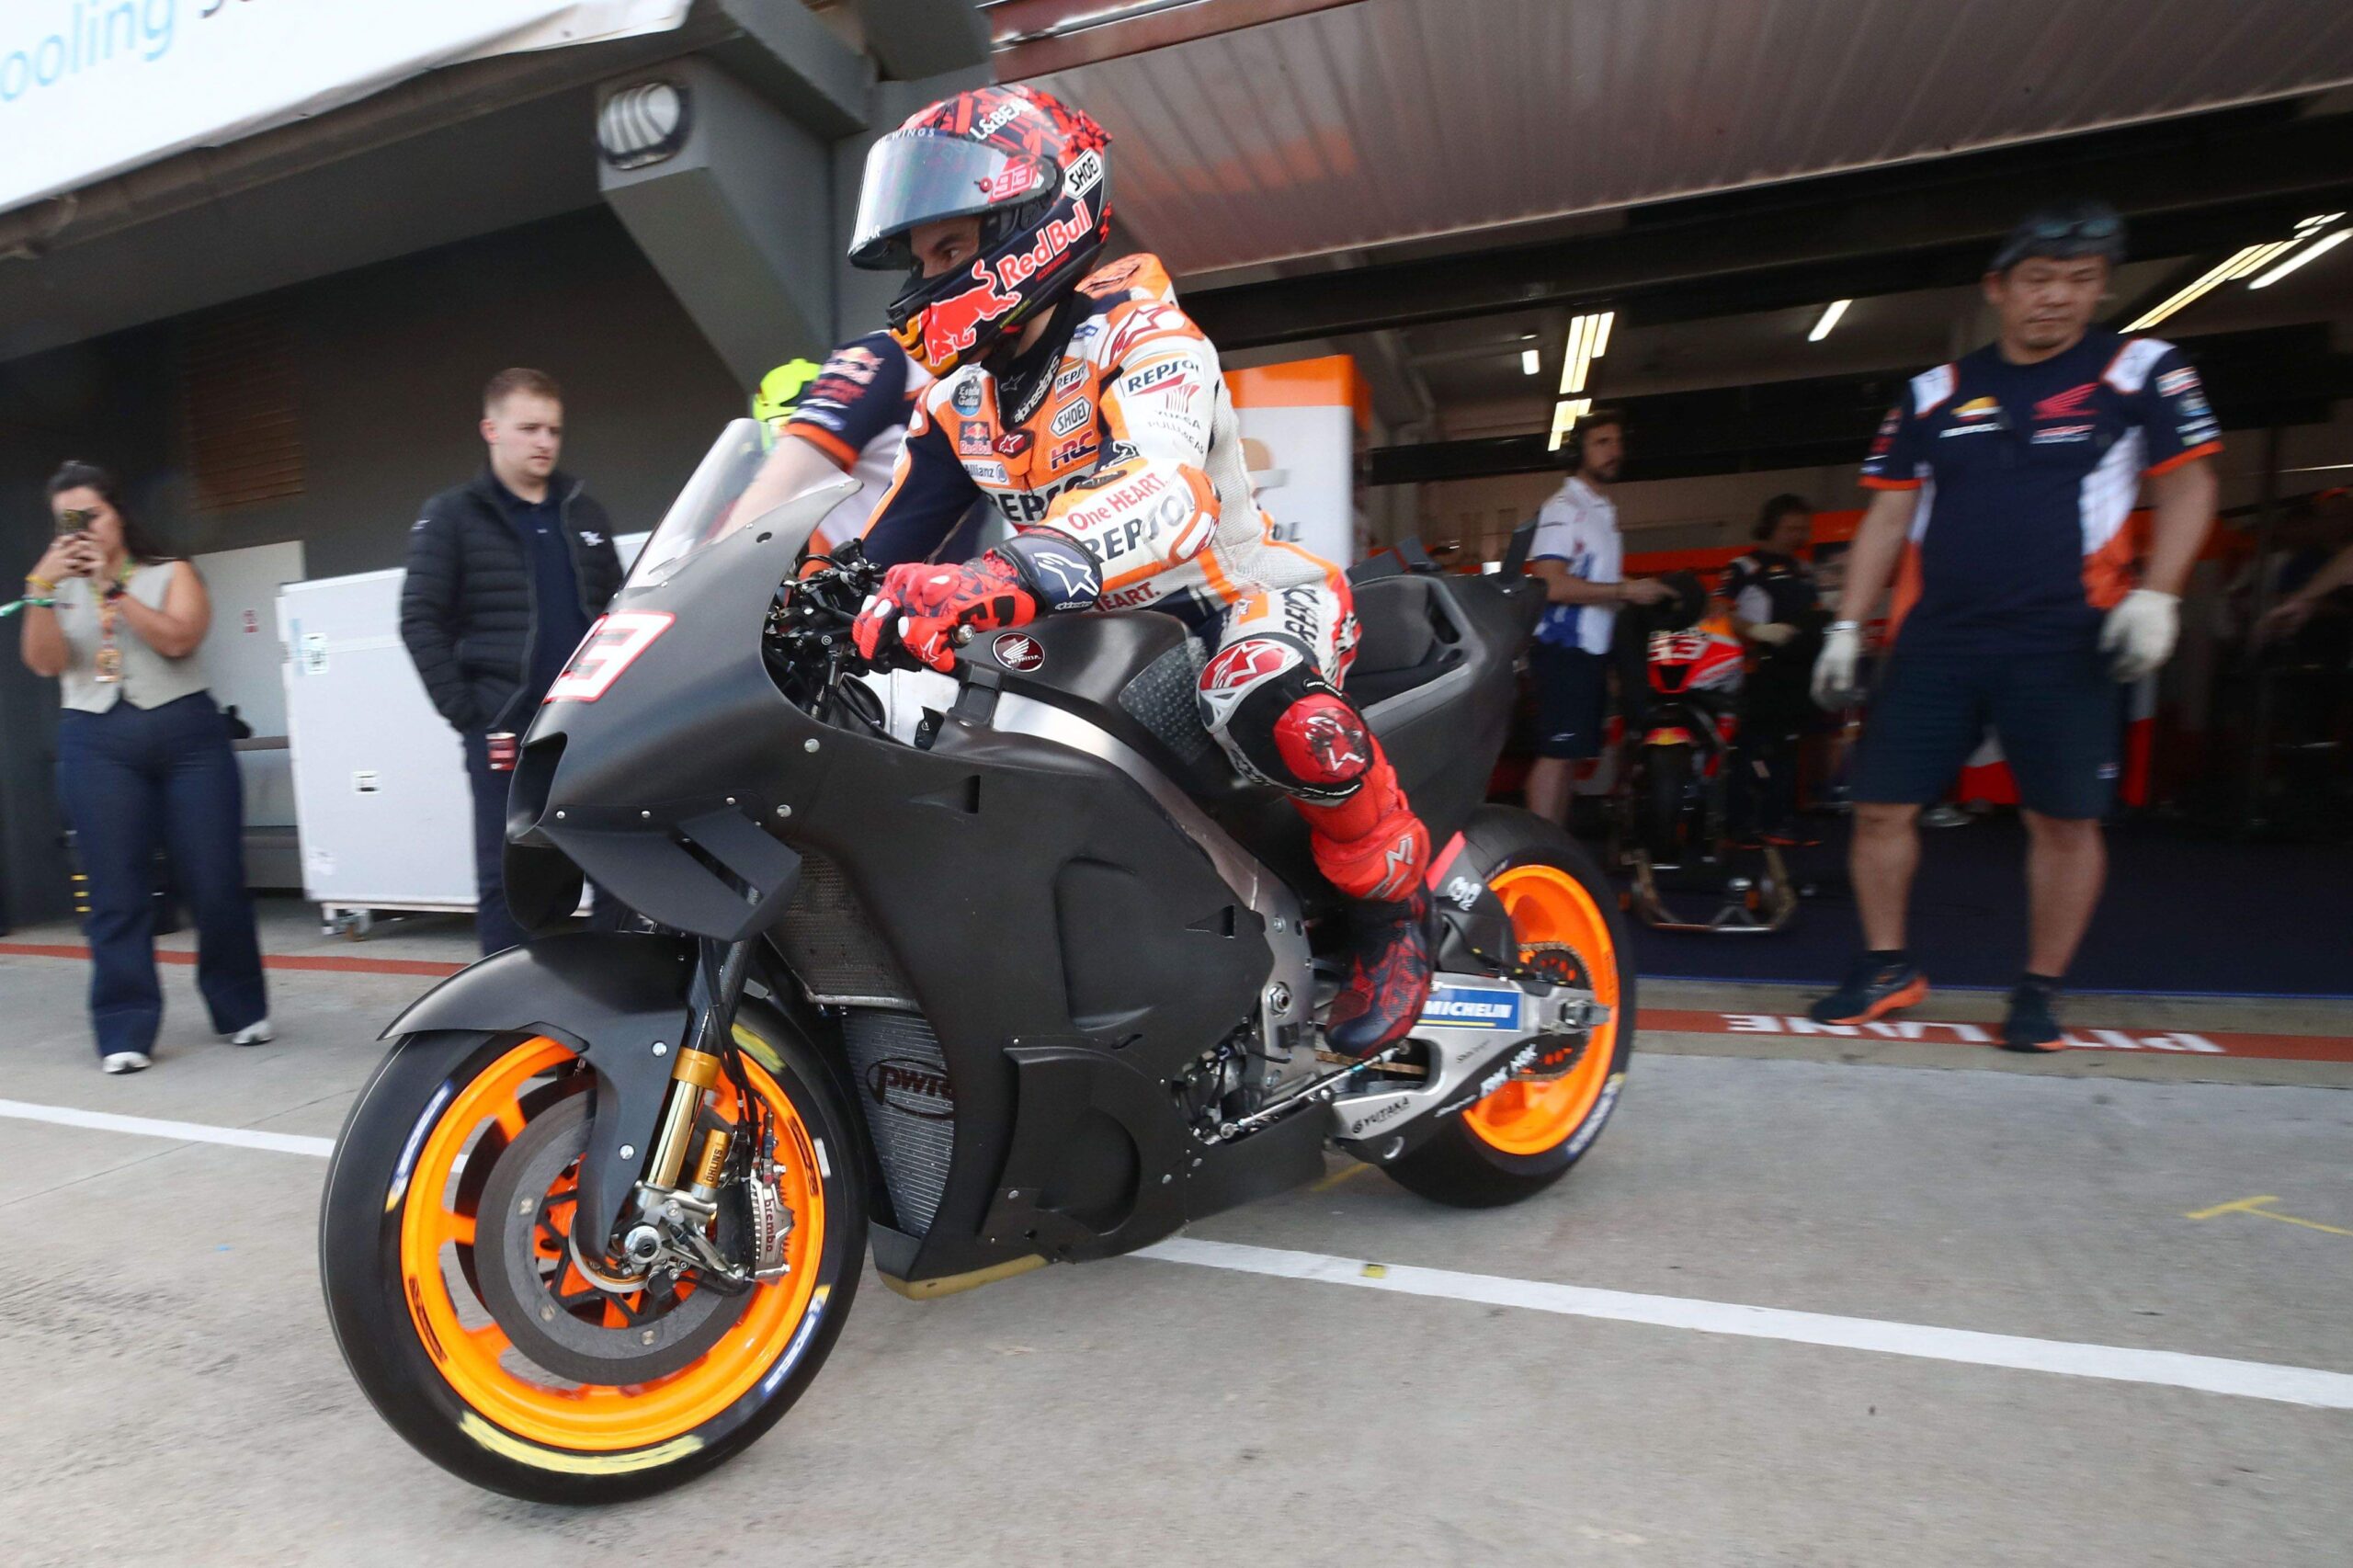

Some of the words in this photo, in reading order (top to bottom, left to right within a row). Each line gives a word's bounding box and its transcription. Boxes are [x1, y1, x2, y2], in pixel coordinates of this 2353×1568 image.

[1057, 402, 1087, 432] SHOEI
[1051, 430, 1097, 470] HRC
[1068, 506, 1111, 530] One
[1423, 1000, 1513, 1018] MICHELIN
[763, 1198, 779, 1252] brembo
